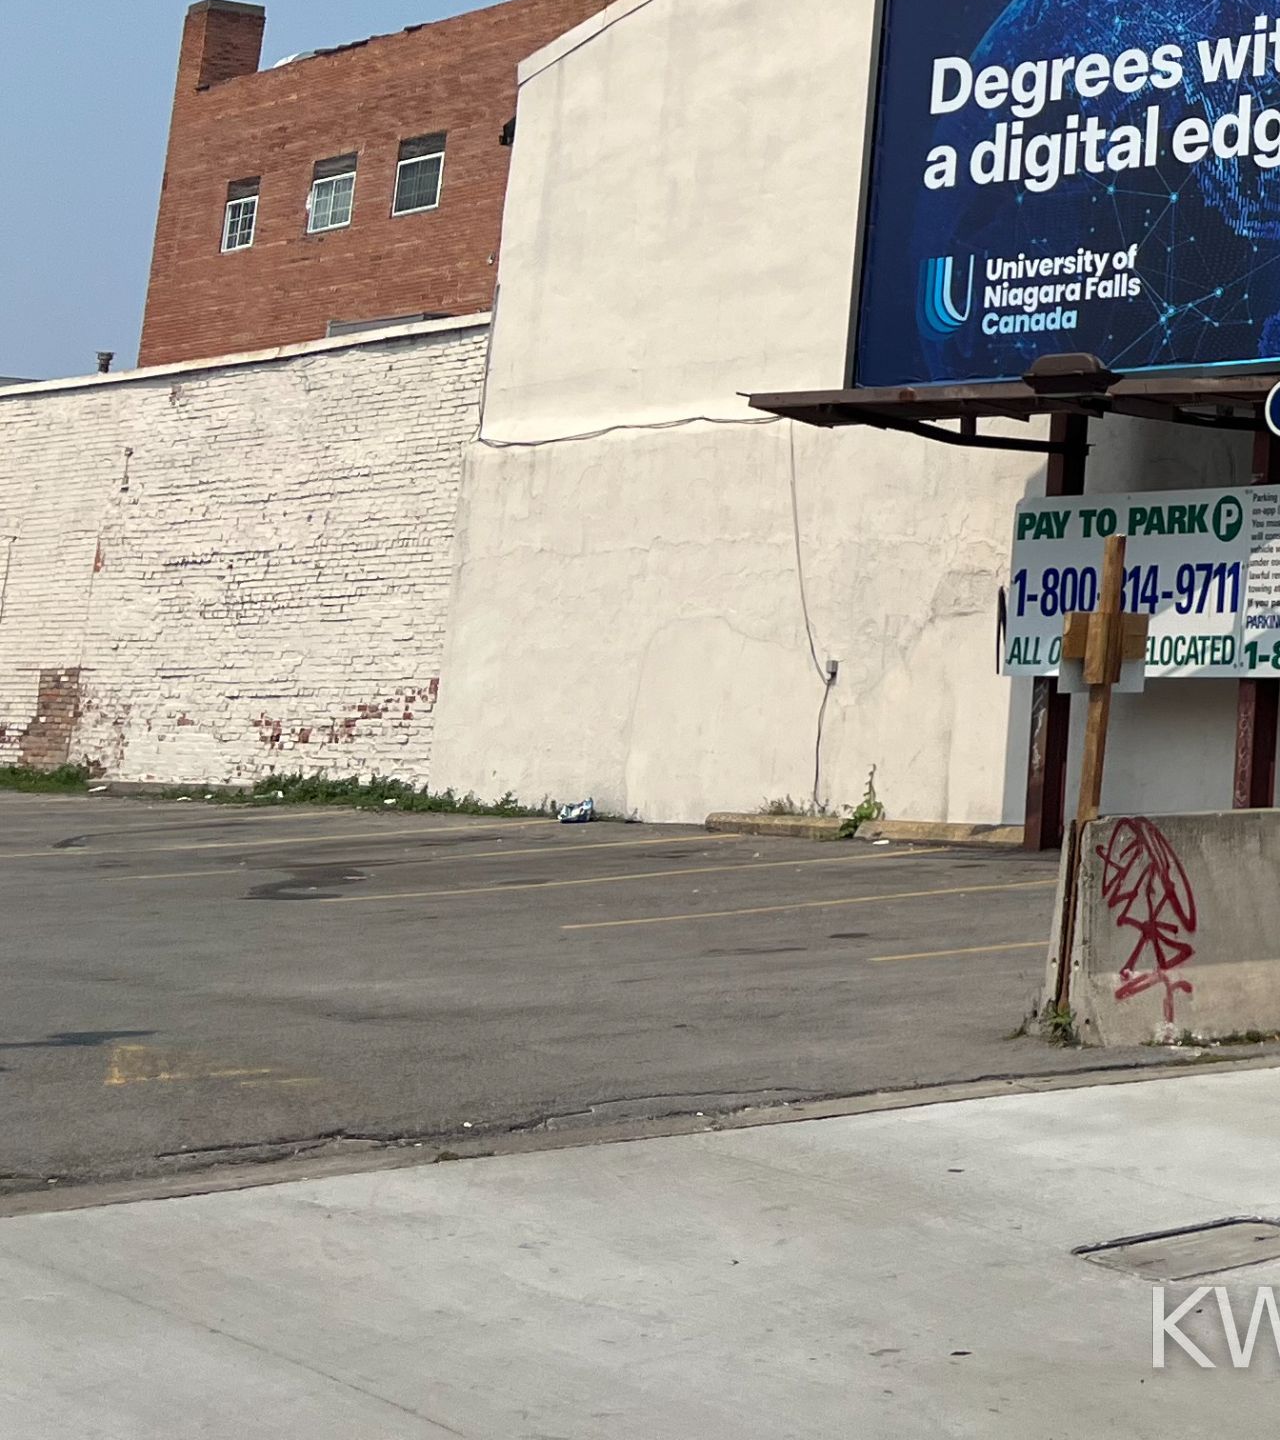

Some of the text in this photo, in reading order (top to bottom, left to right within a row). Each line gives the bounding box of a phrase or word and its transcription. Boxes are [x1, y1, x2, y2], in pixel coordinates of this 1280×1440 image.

[929, 42, 1183, 120] Degrees
[923, 147, 957, 190] a
[970, 105, 1160, 193] digital
[986, 243, 1139, 282] University of
[983, 271, 1141, 312] Niagara Falls
[981, 306, 1078, 336] Canada
[1017, 510, 1071, 540] PAY
[1079, 508, 1117, 538] TO
[1128, 504, 1209, 536] PARK
[1014, 561, 1240, 617] 1-80014-9711
[1009, 636, 1040, 665] ALL
[1144, 635, 1235, 666] LOCATED
